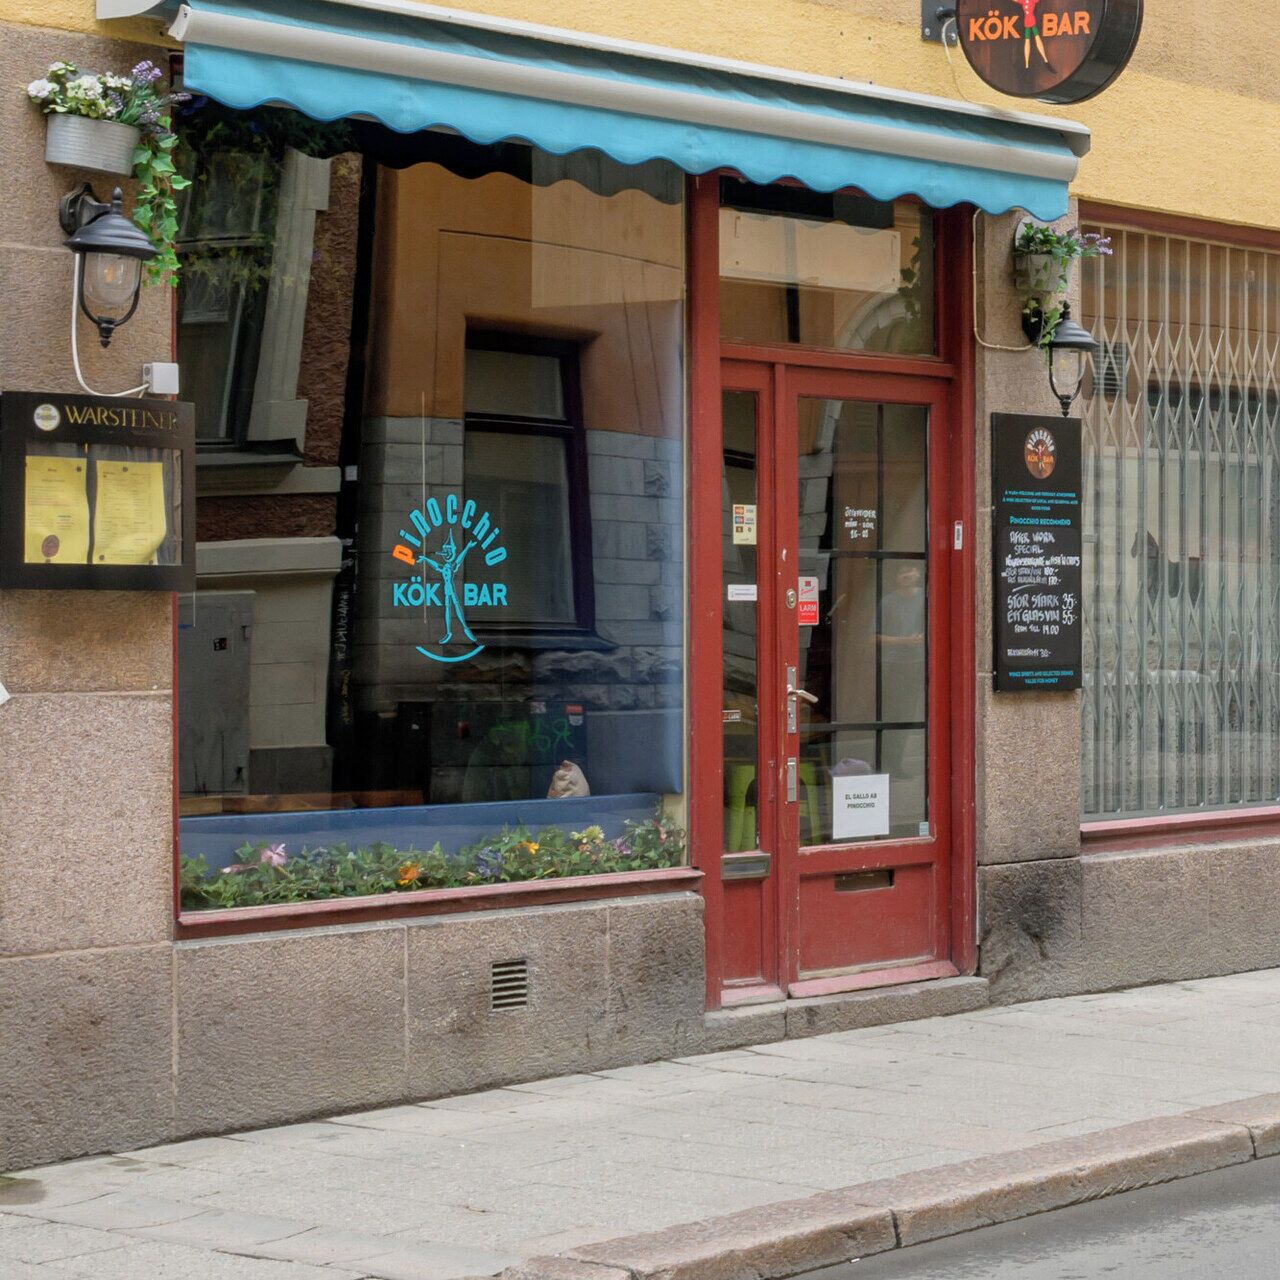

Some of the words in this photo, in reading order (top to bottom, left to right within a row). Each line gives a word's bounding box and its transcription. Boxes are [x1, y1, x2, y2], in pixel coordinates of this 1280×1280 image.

[969, 10, 1021, 42] KÖK
[1042, 11, 1091, 37] BAR
[65, 405, 179, 431] WARSTEINER
[393, 576, 442, 606] KÖK
[464, 584, 508, 606] BAR
[1007, 593, 1029, 609] STOR
[1032, 592, 1059, 609] STARK
